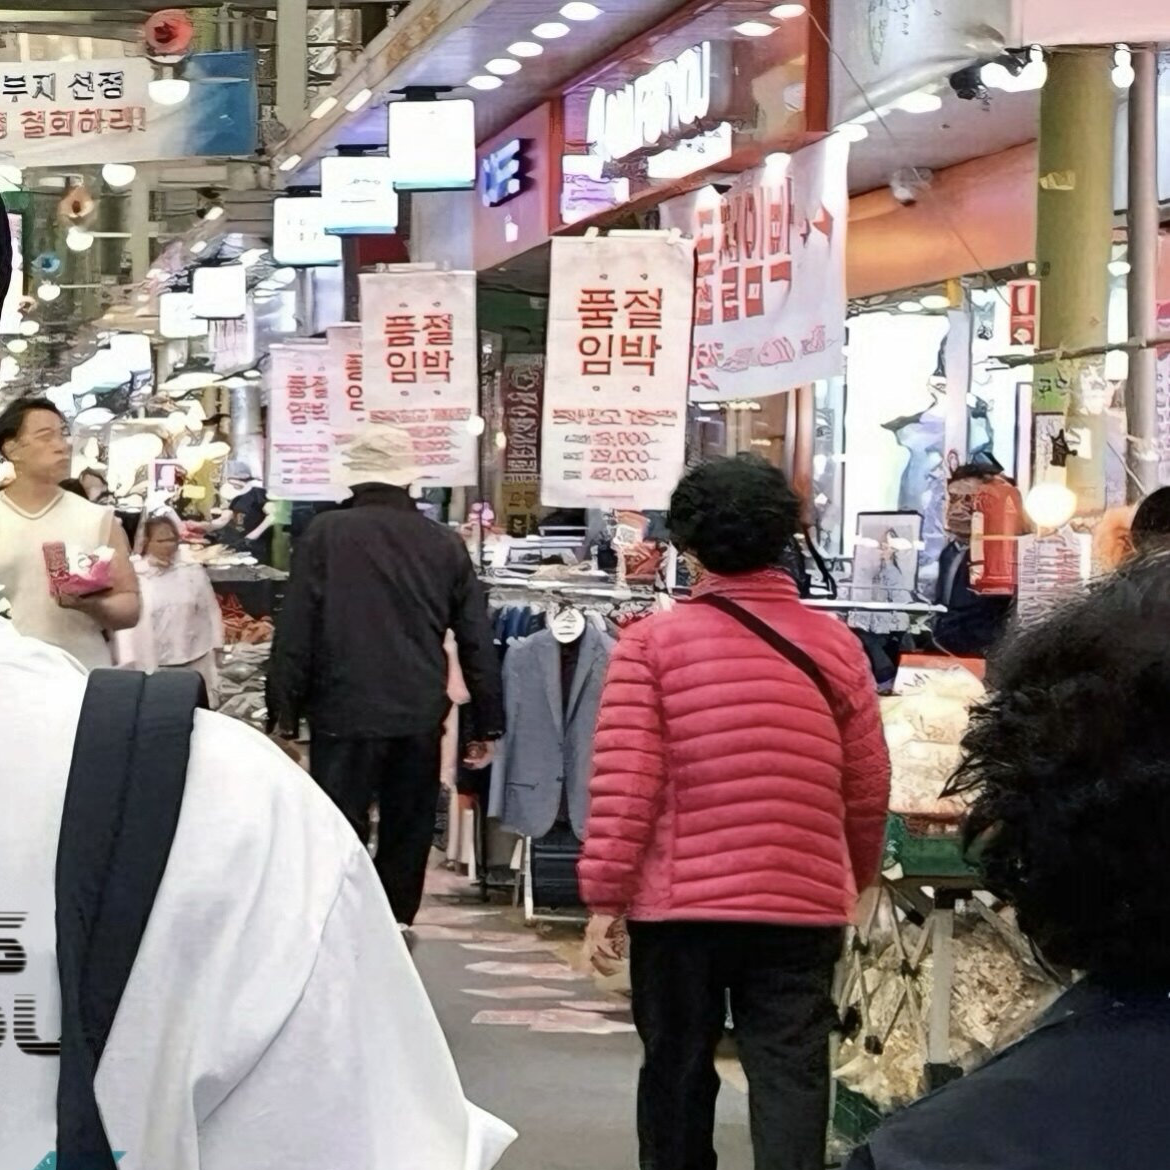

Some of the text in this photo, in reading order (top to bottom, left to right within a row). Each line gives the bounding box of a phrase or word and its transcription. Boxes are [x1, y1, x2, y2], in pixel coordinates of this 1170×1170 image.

[2, 73, 56, 102] 부지
[67, 71, 125, 100] 선정
[577, 288, 663, 329] 품절
[384, 313, 453, 347] 품절
[386, 351, 453, 383] 임박
[578, 334, 662, 377] 임박
